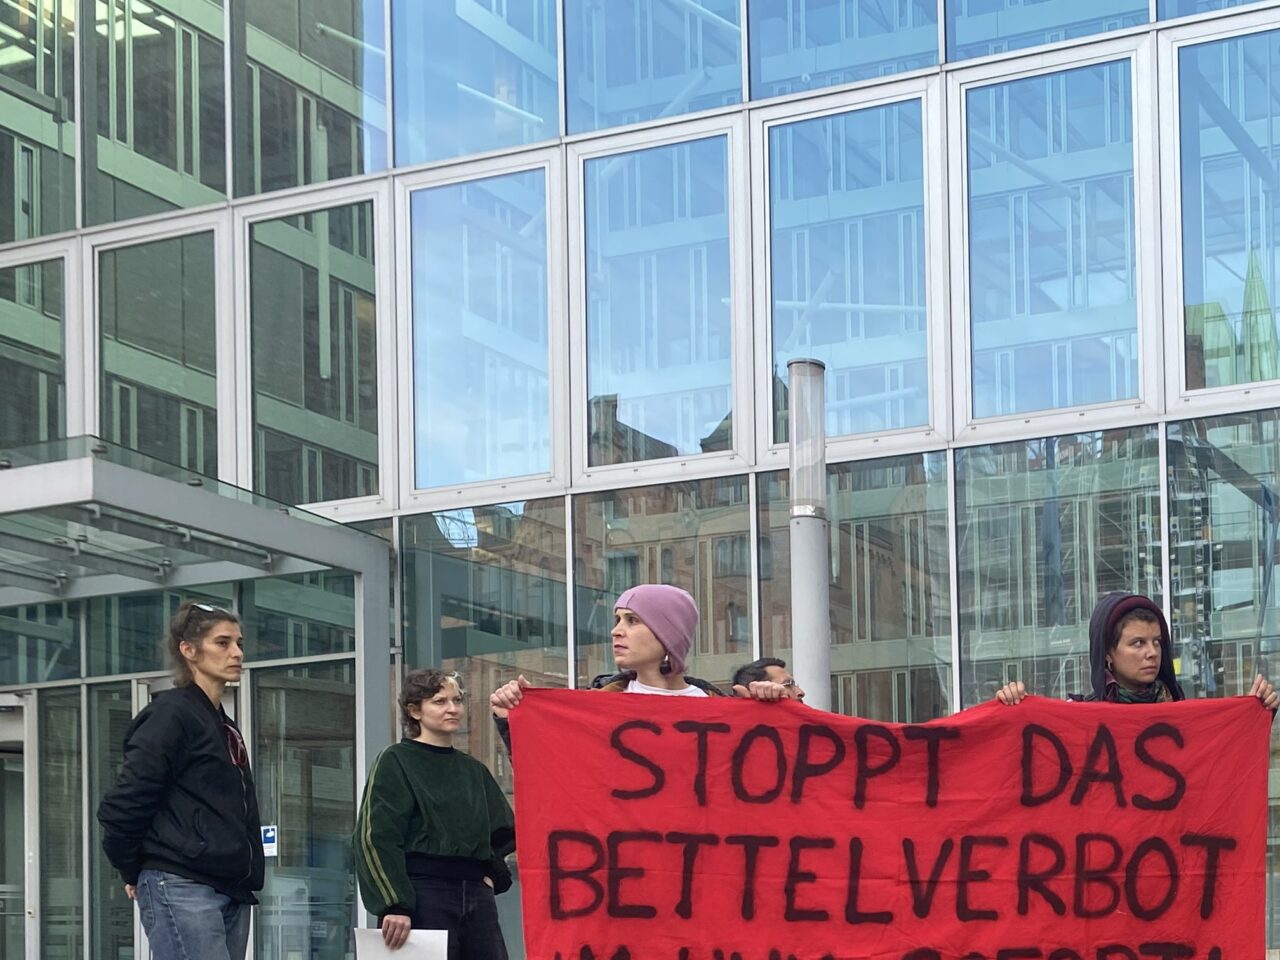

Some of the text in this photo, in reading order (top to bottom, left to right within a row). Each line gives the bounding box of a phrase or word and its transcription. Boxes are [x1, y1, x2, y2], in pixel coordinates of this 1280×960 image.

[610, 719, 1188, 811] STOPPT DAS
[548, 831, 1237, 924] BETTELVERBOT
